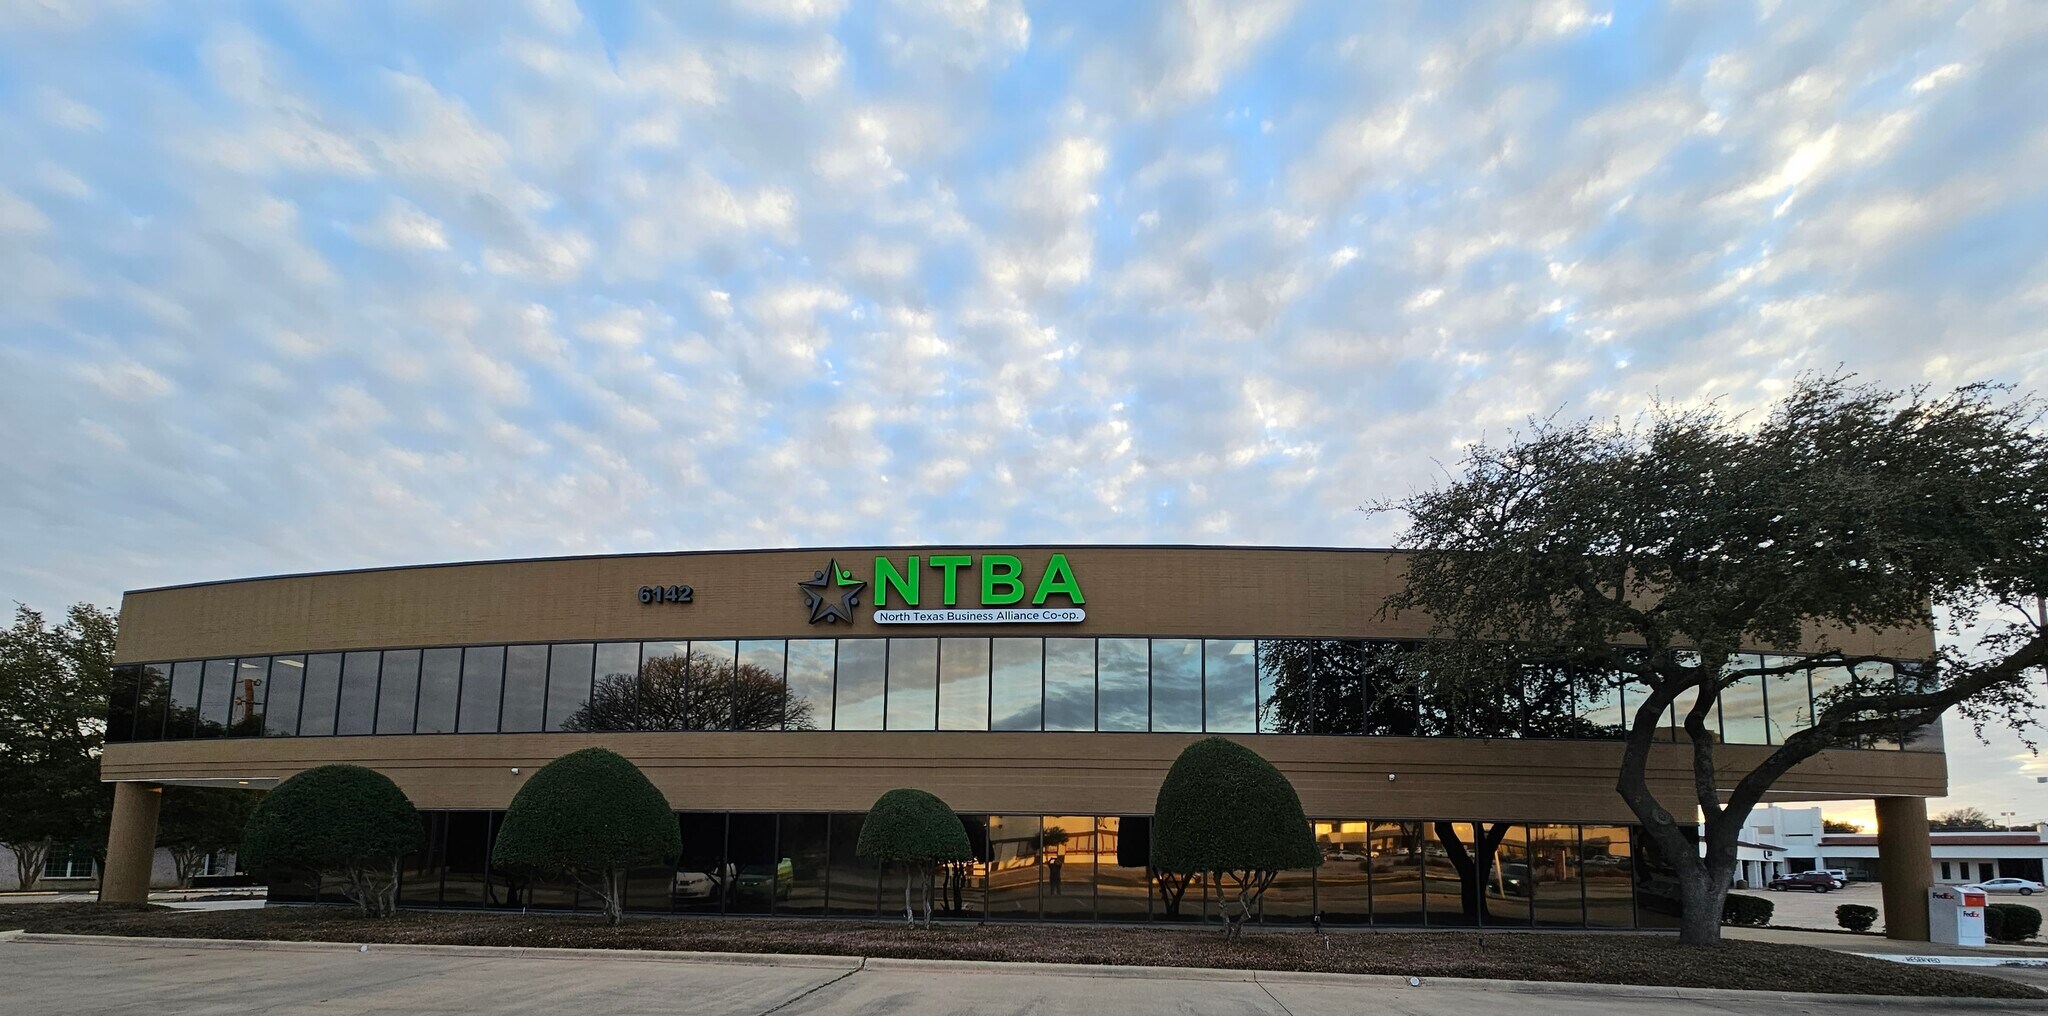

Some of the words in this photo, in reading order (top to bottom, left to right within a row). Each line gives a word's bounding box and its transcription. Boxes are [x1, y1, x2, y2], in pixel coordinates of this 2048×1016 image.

[874, 553, 1085, 606] NTBA
[638, 585, 693, 604] 6142
[880, 612, 910, 621] North
[913, 612, 944, 621] Texas
[947, 611, 993, 621] Business
[996, 611, 1039, 621] Alliance
[1042, 610, 1079, 622] Co-op.
[1932, 892, 1954, 900] FedEx
